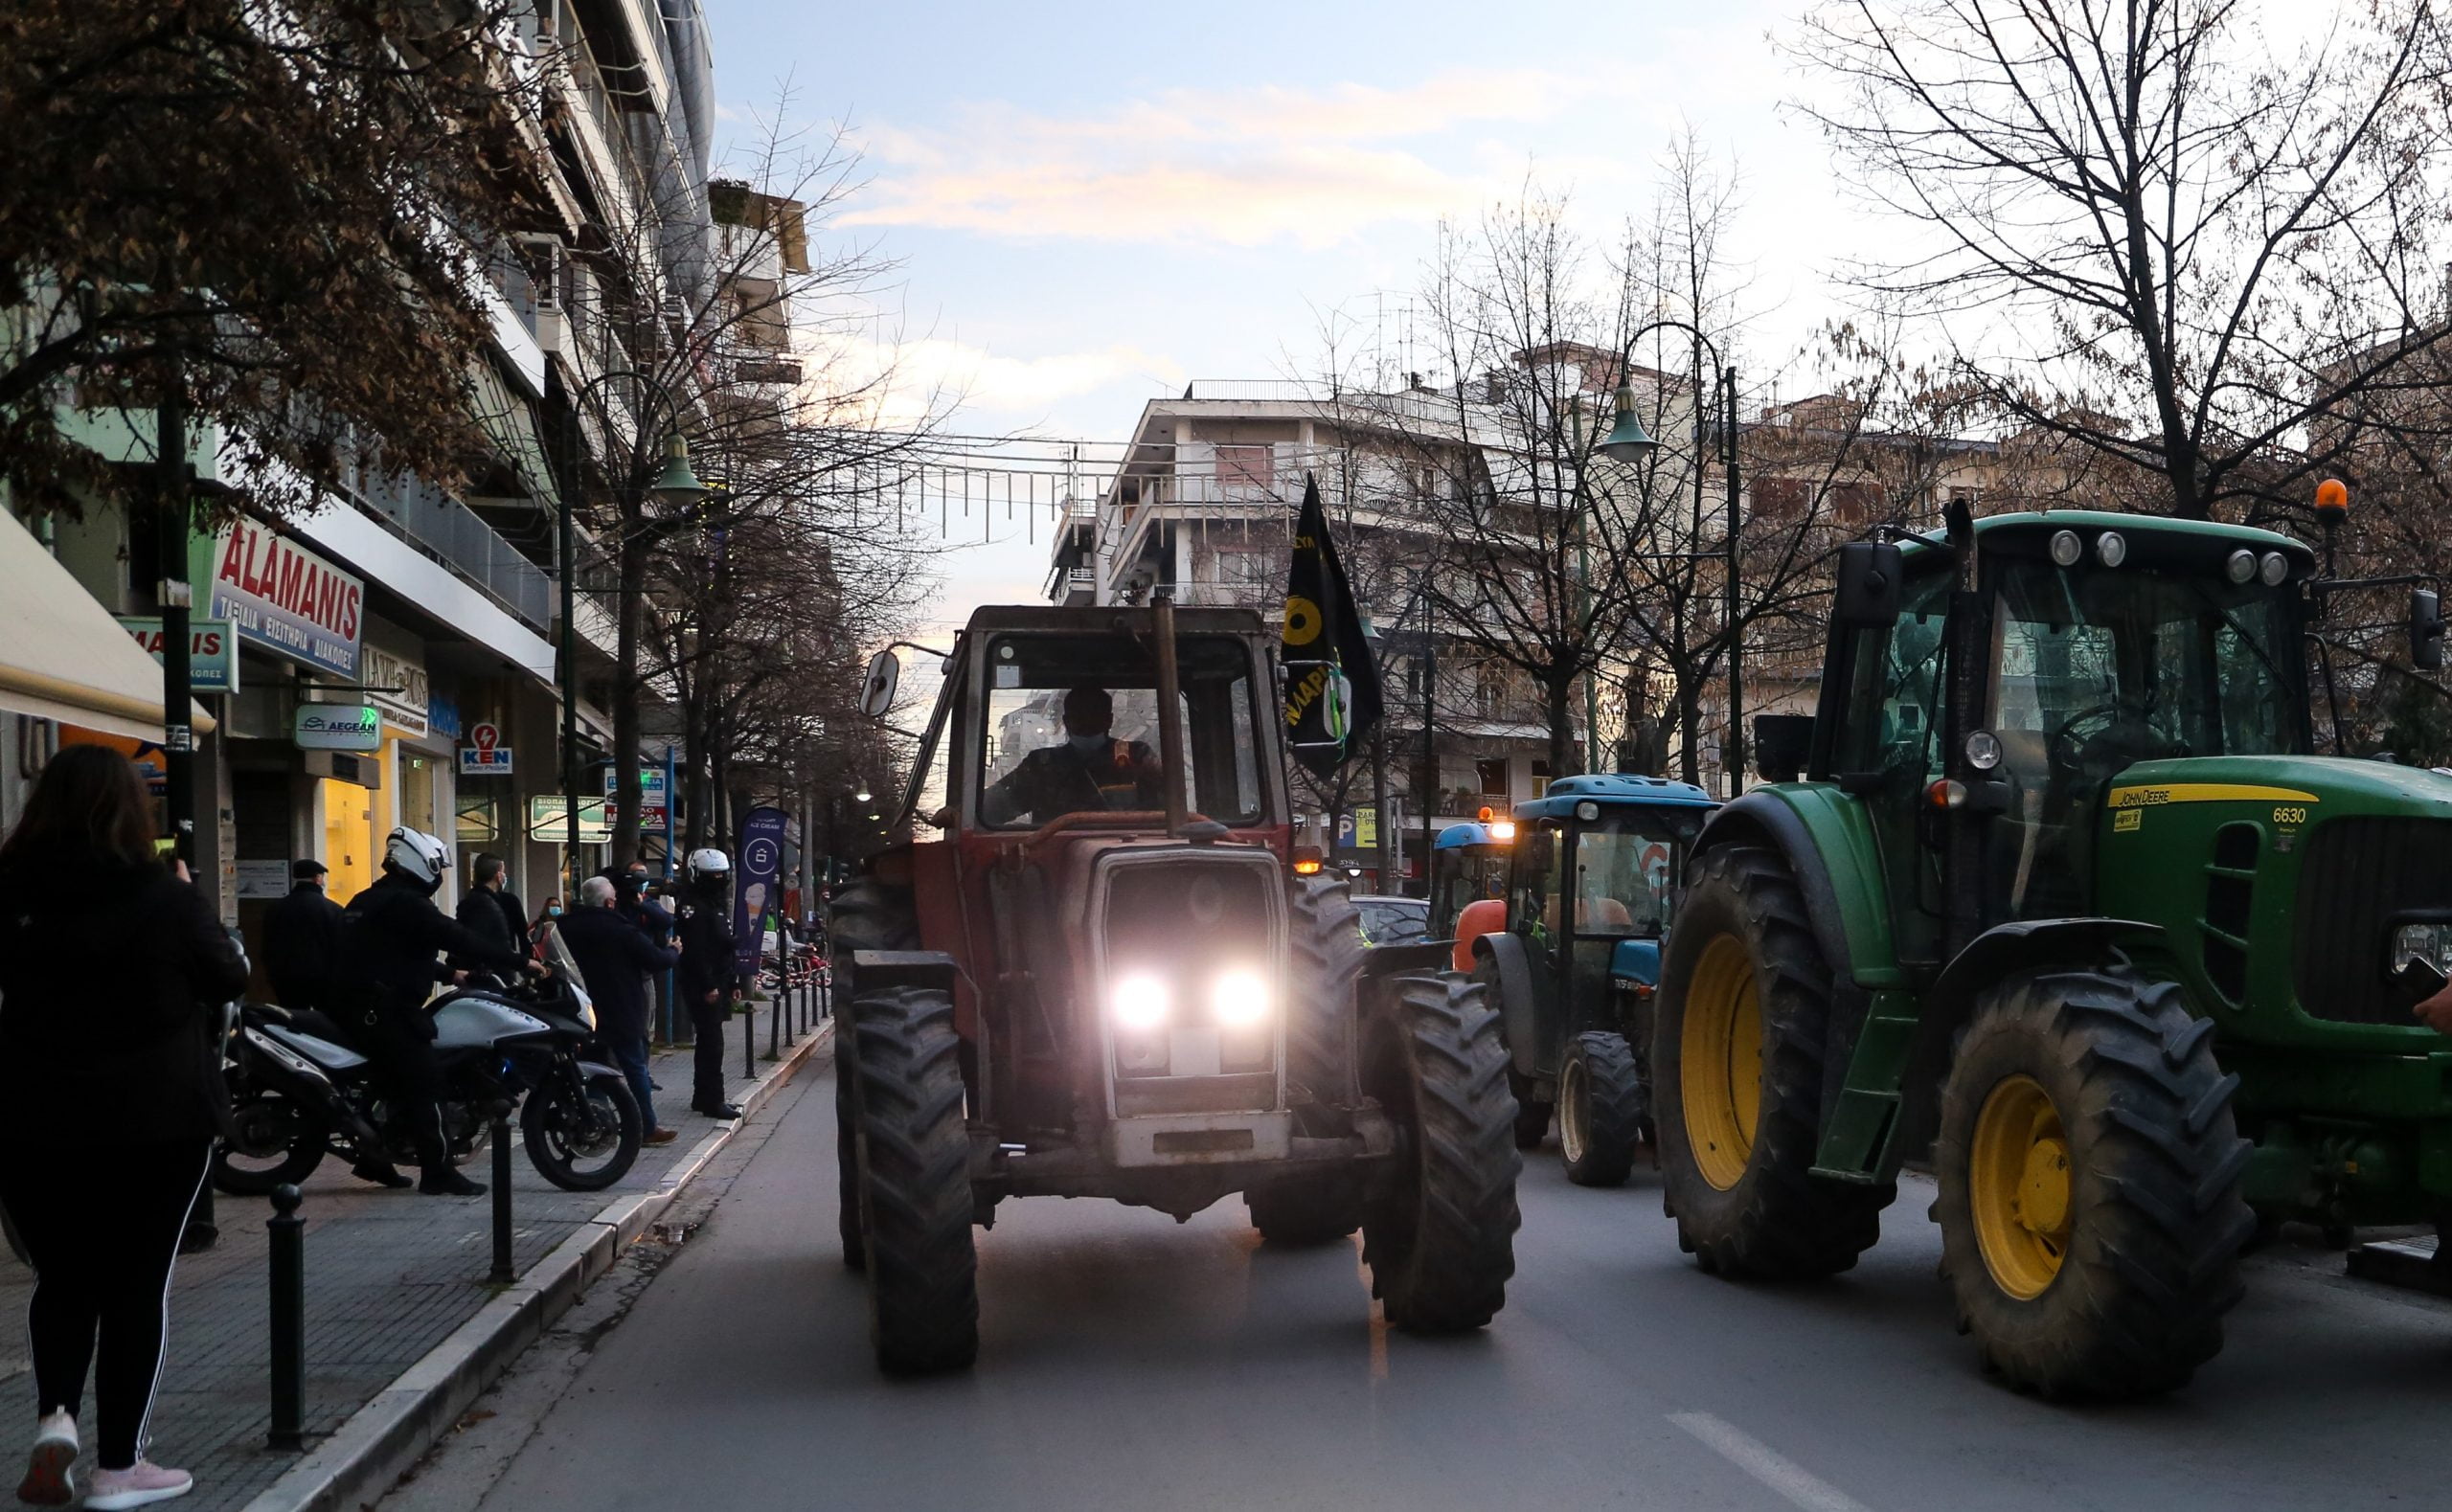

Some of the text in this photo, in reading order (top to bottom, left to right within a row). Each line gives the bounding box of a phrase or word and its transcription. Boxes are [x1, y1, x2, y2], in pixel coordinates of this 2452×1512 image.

[219, 520, 359, 643] ALAMANIS
[220, 596, 352, 670] ΤΑΞΙΔΙΑ ΕΙΣΙΤΗΡΙΑ ΔΙΑΚΟΠΕΣ
[329, 722, 376, 732] AEGEAN
[464, 751, 510, 764] KEN
[2120, 790, 2169, 805] JOHN DEERE
[2274, 807, 2306, 824] 6630
